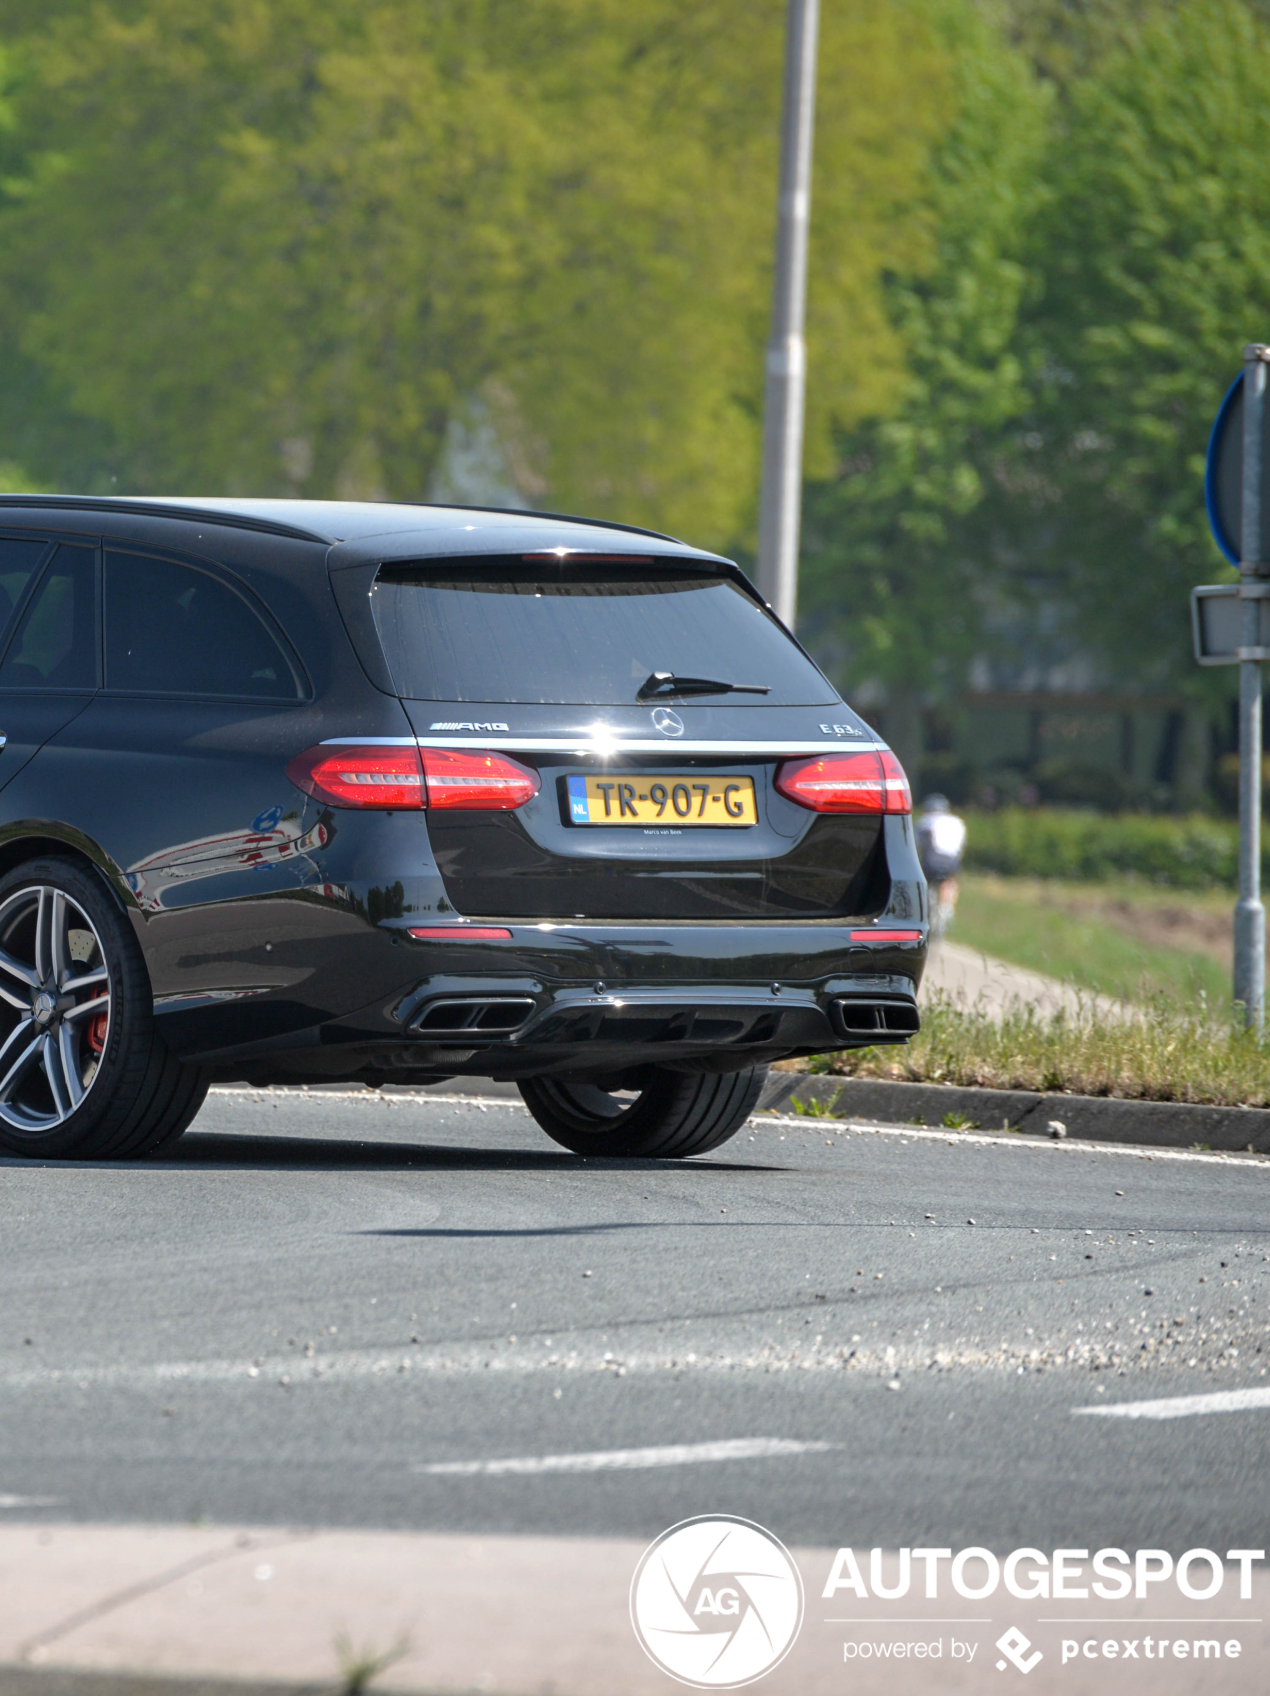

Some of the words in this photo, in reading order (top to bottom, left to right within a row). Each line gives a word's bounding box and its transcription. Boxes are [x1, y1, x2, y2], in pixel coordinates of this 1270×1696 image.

[457, 722, 509, 732] AMG
[597, 783, 744, 818] TR-907-G
[573, 804, 587, 815] NL
